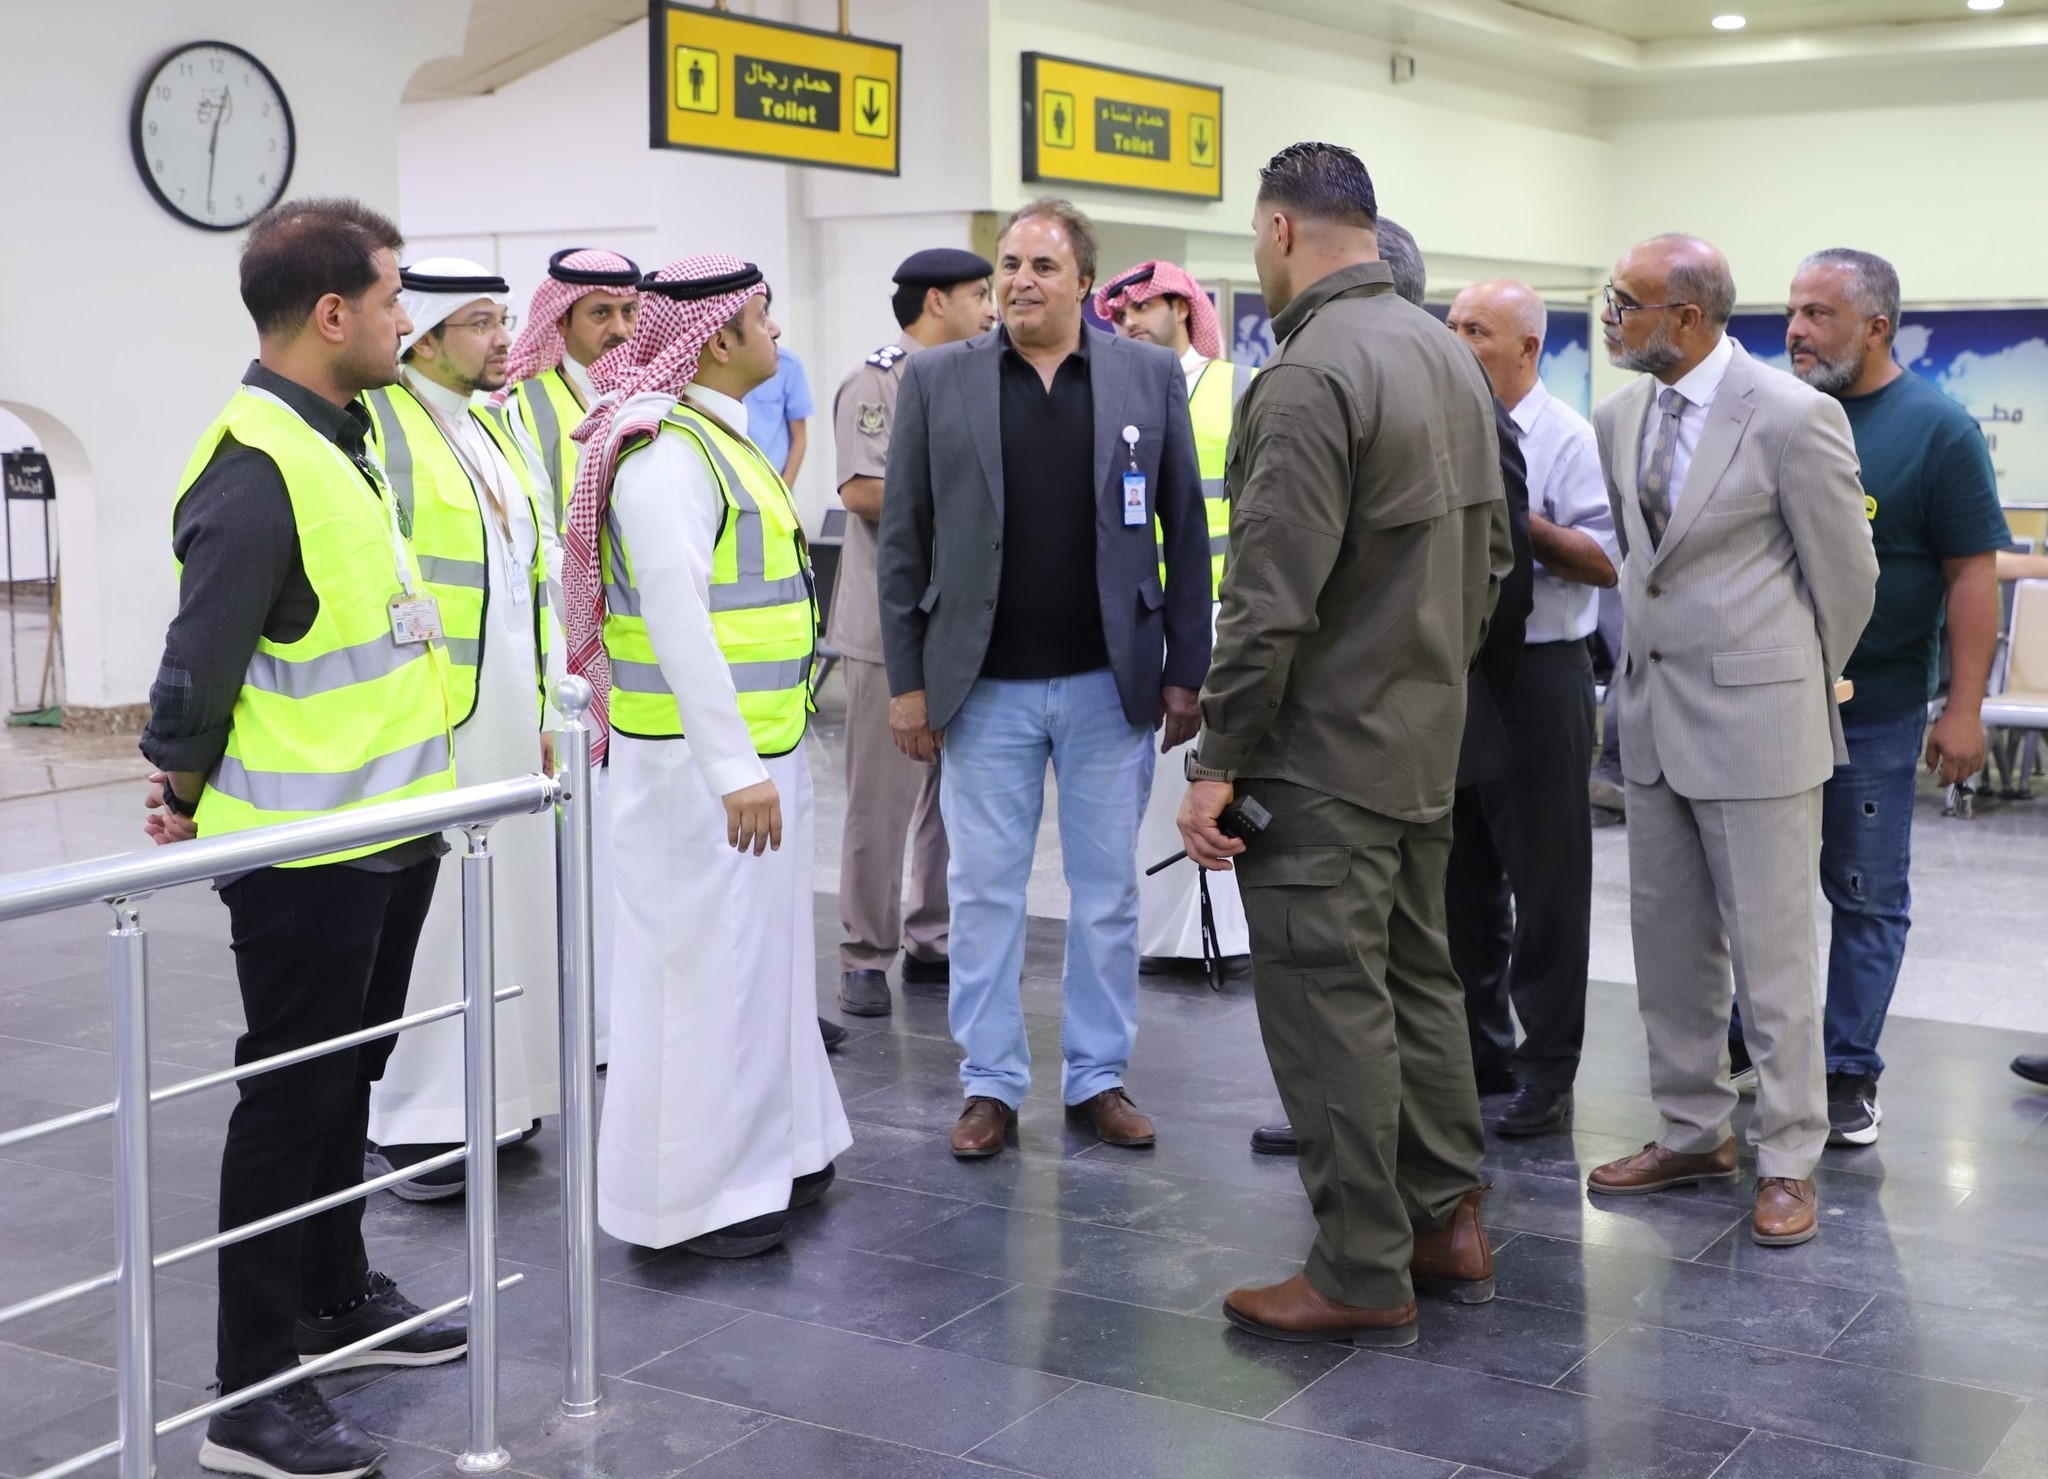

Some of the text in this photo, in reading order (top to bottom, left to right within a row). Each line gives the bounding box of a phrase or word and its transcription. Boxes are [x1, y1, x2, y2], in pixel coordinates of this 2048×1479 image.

[179, 63, 193, 77] 11
[209, 58, 225, 74] 12
[243, 73, 250, 87] 1
[744, 62, 832, 96] حمام رجال
[156, 85, 171, 101] 10
[262, 103, 271, 118] 2
[760, 96, 817, 124] Toilet
[1101, 103, 1164, 131] حمام نساء
[148, 121, 158, 136] 9
[1113, 131, 1154, 155] Toilet
[155, 159, 164, 174] 8
[178, 187, 186, 201] 7
[236, 195, 244, 210] 5
